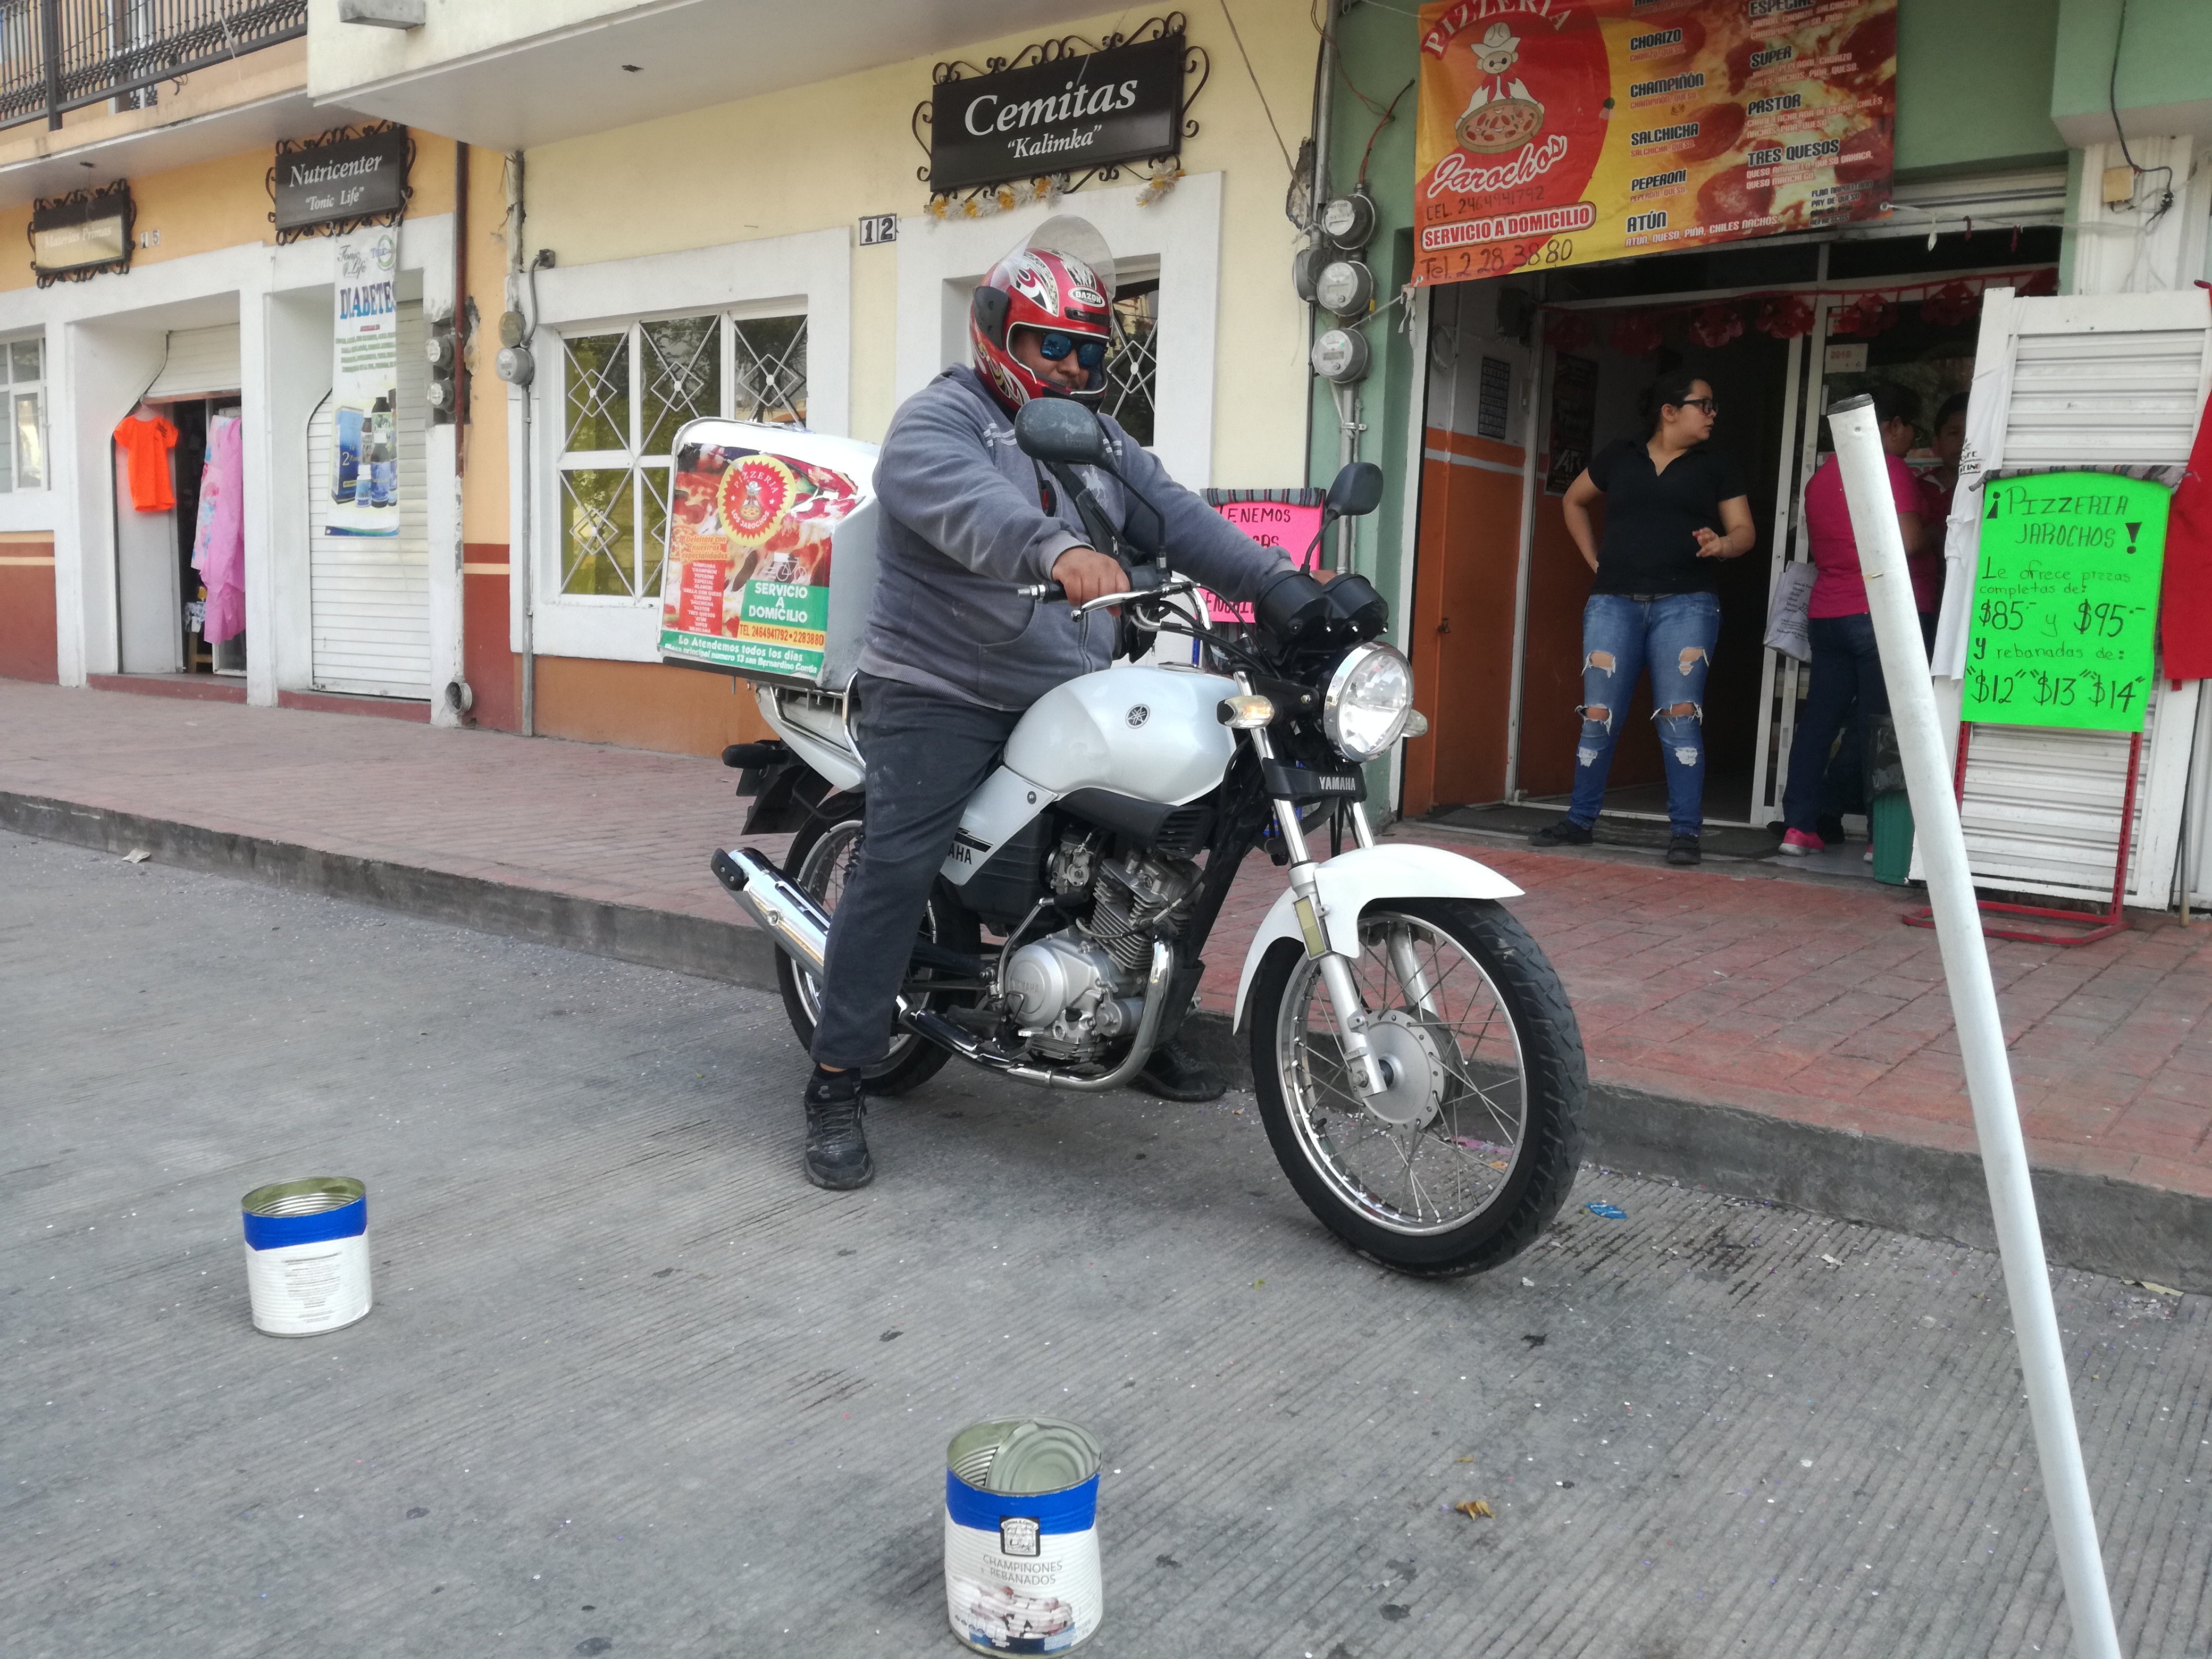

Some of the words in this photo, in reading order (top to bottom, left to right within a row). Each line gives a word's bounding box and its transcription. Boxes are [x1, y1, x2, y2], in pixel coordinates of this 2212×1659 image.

[1630, 29, 1682, 51] CHORIZO
[1751, 45, 1792, 68] SUPER
[1630, 72, 1704, 98] CHAMPIÑÓN
[965, 79, 1138, 137] Cemitas
[1748, 94, 1802, 115] PASTOR
[1631, 123, 1699, 146] SALCHICHA
[1748, 148, 1781, 166] TRES
[1786, 139, 1839, 161] QUESOS
[289, 155, 382, 187] Nutricenter
[1428, 136, 1568, 197] Jarochos
[1746, 167, 1770, 179] QUESO
[1815, 156, 1839, 168] QUESO
[1631, 169, 1687, 191] PEPERONI
[1746, 178, 1770, 189] QUESO
[1811, 199, 1825, 207] PAY
[1838, 192, 1860, 203] QUESO
[864, 217, 893, 243] 12
[1425, 222, 1491, 247] SERVICIO
[1494, 220, 1505, 237] A
[1509, 208, 1590, 234] DOMICILIO
[1627, 211, 1667, 233] ATÚN
[1653, 231, 1681, 243] QUESO,
[1709, 221, 1739, 234] CHILES
[1742, 215, 1779, 229] NACHOS.
[1810, 214, 1849, 225] REFRESCOS
[45, 233, 80, 249] Materias
[82, 227, 112, 241] Primas
[1075, 291, 1101, 304] DAZON
[734, 471, 778, 493] PIZZERIA
[731, 509, 741, 523] LOS
[740, 510, 770, 530] JAROCHOS
[1982, 556, 2007, 579] Le
[2020, 560, 2071, 580] ofrece
[2082, 572, 2131, 588] pizzas
[755, 582, 808, 599] SERVICIO
[1980, 582, 2055, 599] completas
[2063, 583, 2087, 594] de:
[775, 597, 785, 608] A
[749, 605, 808, 623] DOMICILIO
[2041, 613, 2058, 637] y
[740, 624, 750, 636] TEL
[678, 635, 689, 646] Lo
[691, 637, 739, 653] Atendemos
[742, 645, 766, 657] todos
[768, 648, 782, 659] los
[1973, 638, 1987, 659] y
[1997, 641, 2083, 659] rebanadas
[2096, 647, 2125, 660] de:
[736, 654, 744, 663] 13
[758, 657, 794, 671] Bernardino
[1319, 776, 1356, 791] YAMAHA
[948, 843, 972, 865] AHA
[983, 1554, 1063, 1574] CHAMPIÑONES
[990, 1567, 1056, 1586] REBANADOS
